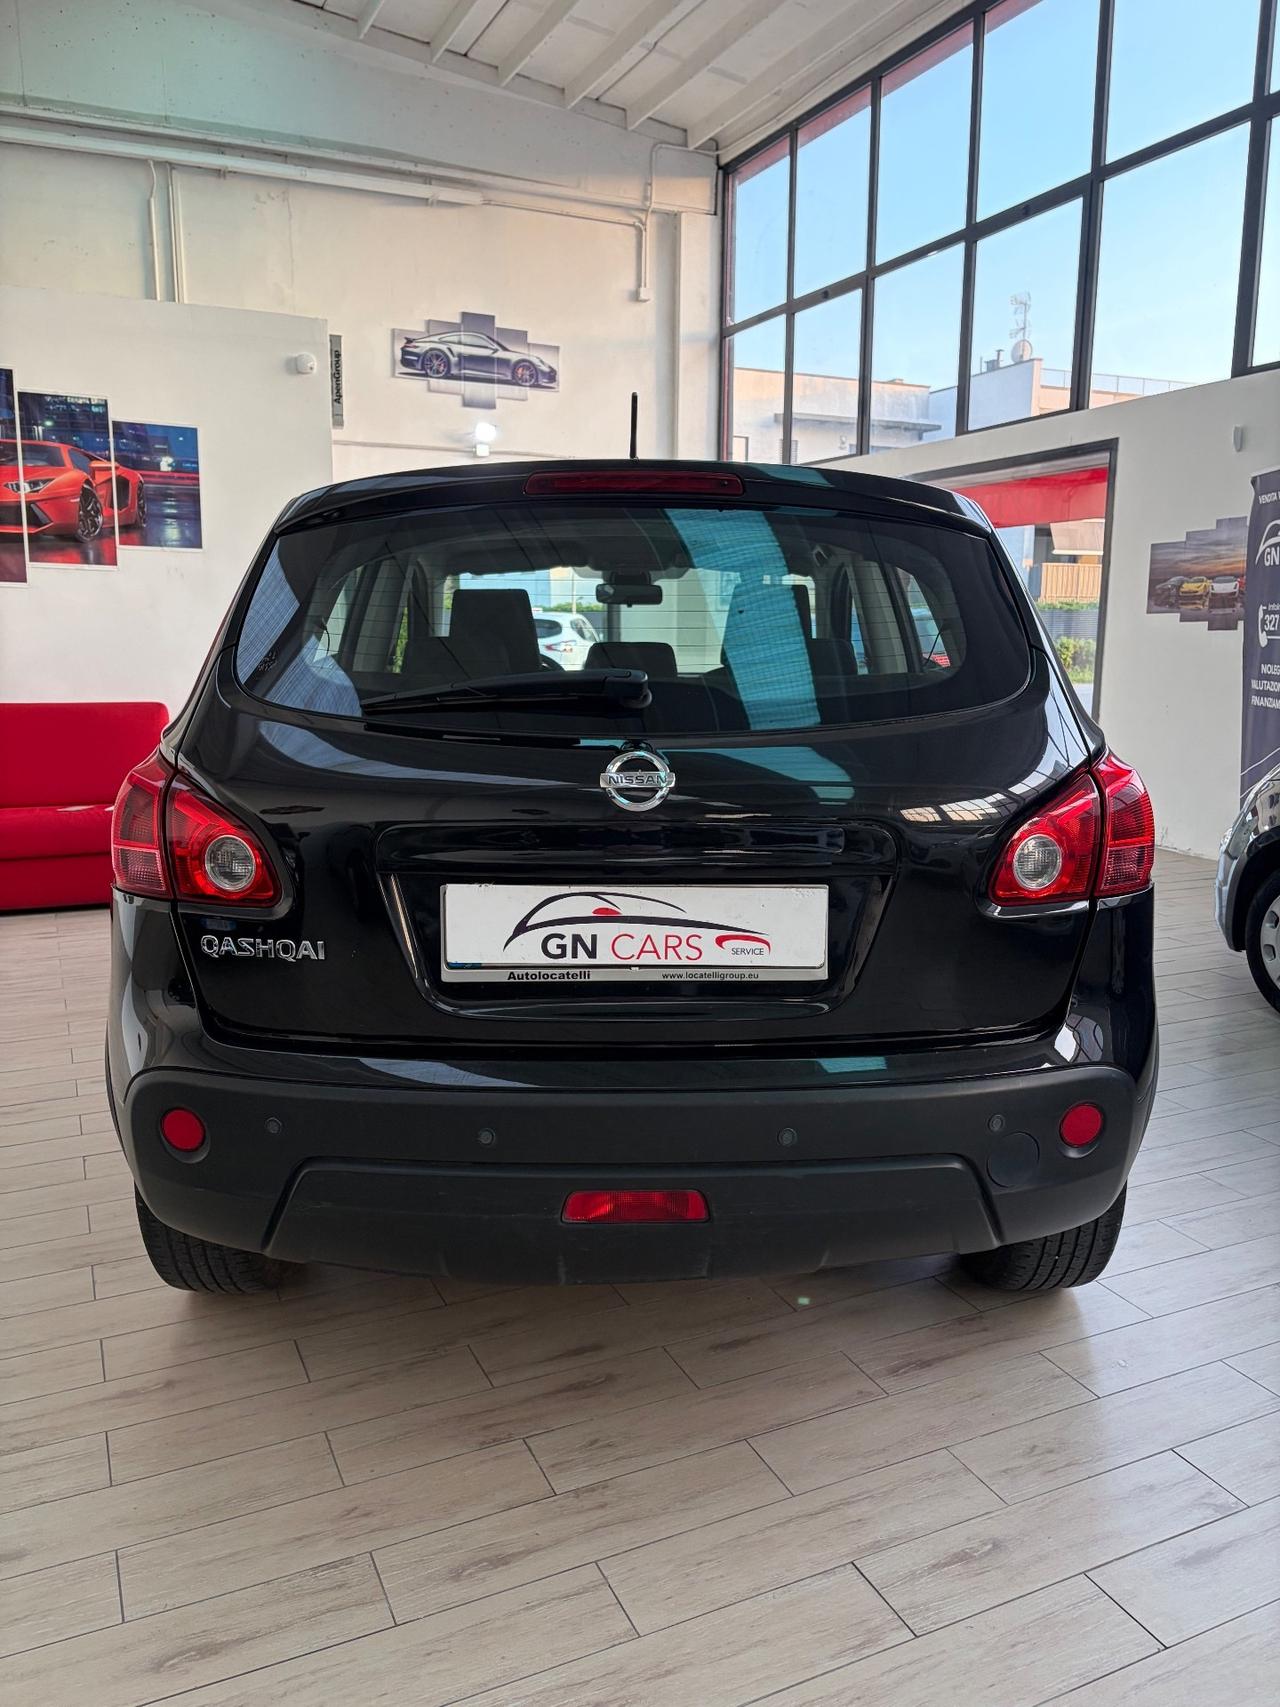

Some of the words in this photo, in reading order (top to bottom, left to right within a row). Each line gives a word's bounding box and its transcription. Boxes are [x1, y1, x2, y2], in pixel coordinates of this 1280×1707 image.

[333, 350, 342, 404] ApenGroup
[1264, 546, 1280, 566] GN
[1264, 614, 1280, 631] 327
[608, 775, 667, 785] NISSAN
[201, 935, 325, 962] QASHQAI
[541, 933, 597, 959] GN
[611, 933, 703, 960] CARS
[731, 947, 764, 956] SERVICE
[507, 970, 591, 981] Autolocatelli
[662, 971, 759, 981] www.locatelligroup.eu
